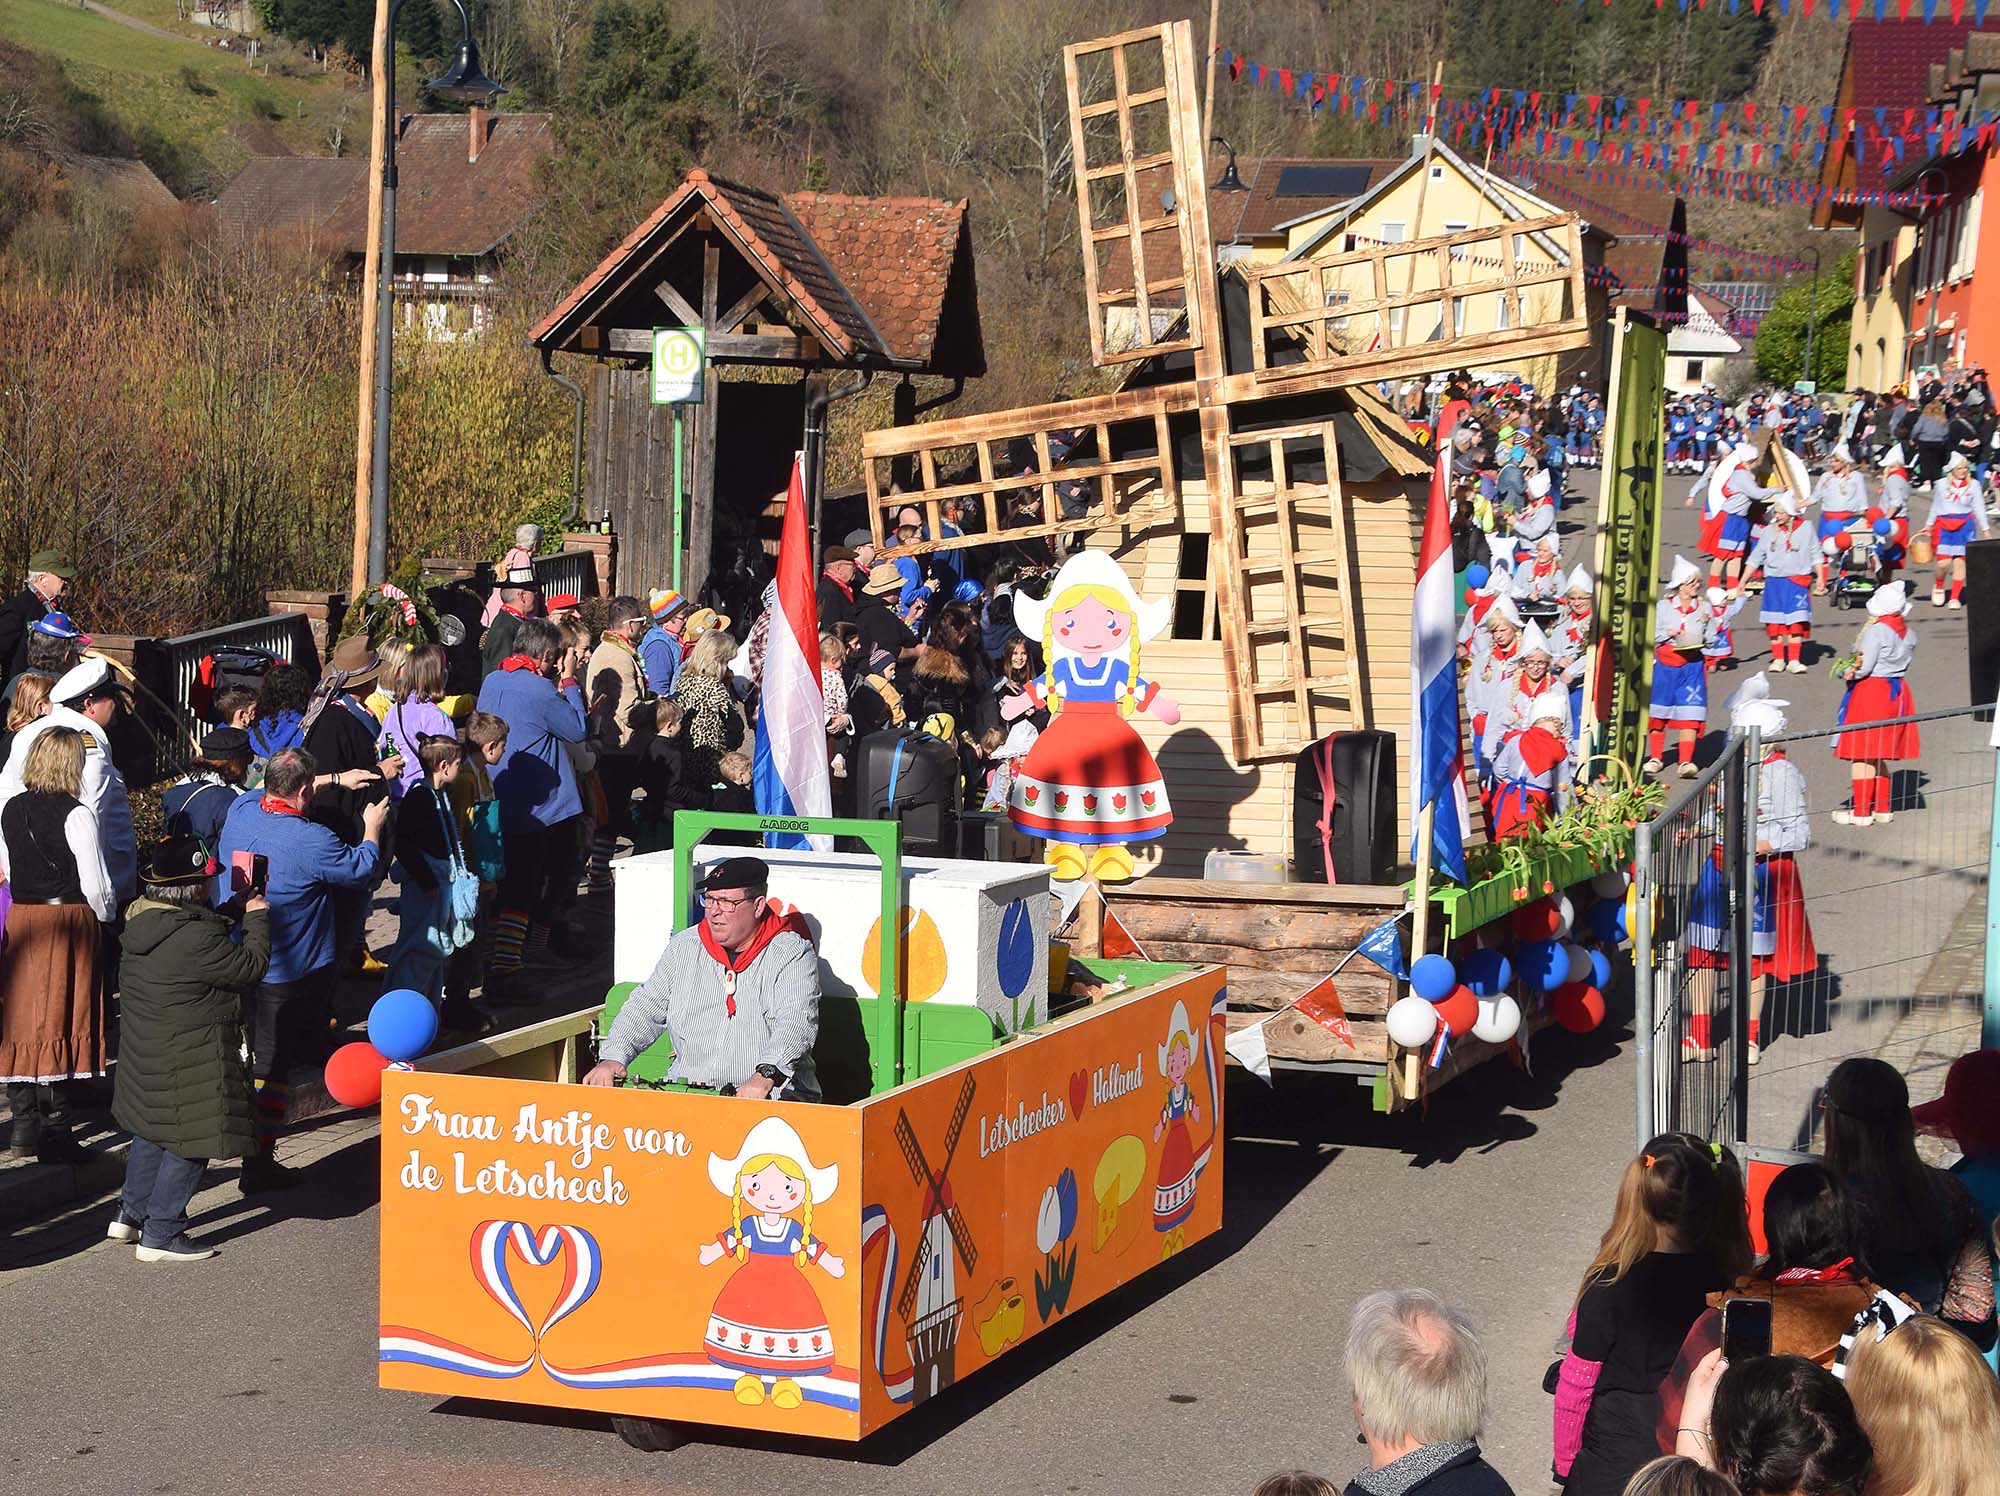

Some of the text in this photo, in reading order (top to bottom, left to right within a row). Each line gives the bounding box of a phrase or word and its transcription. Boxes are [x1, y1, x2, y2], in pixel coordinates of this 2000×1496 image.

[760, 819, 809, 831] LADOG
[400, 1092, 693, 1170] Frau Antje von
[979, 1052, 1143, 1158] Letschecker Holland
[400, 1149, 630, 1207] de Letscheck
